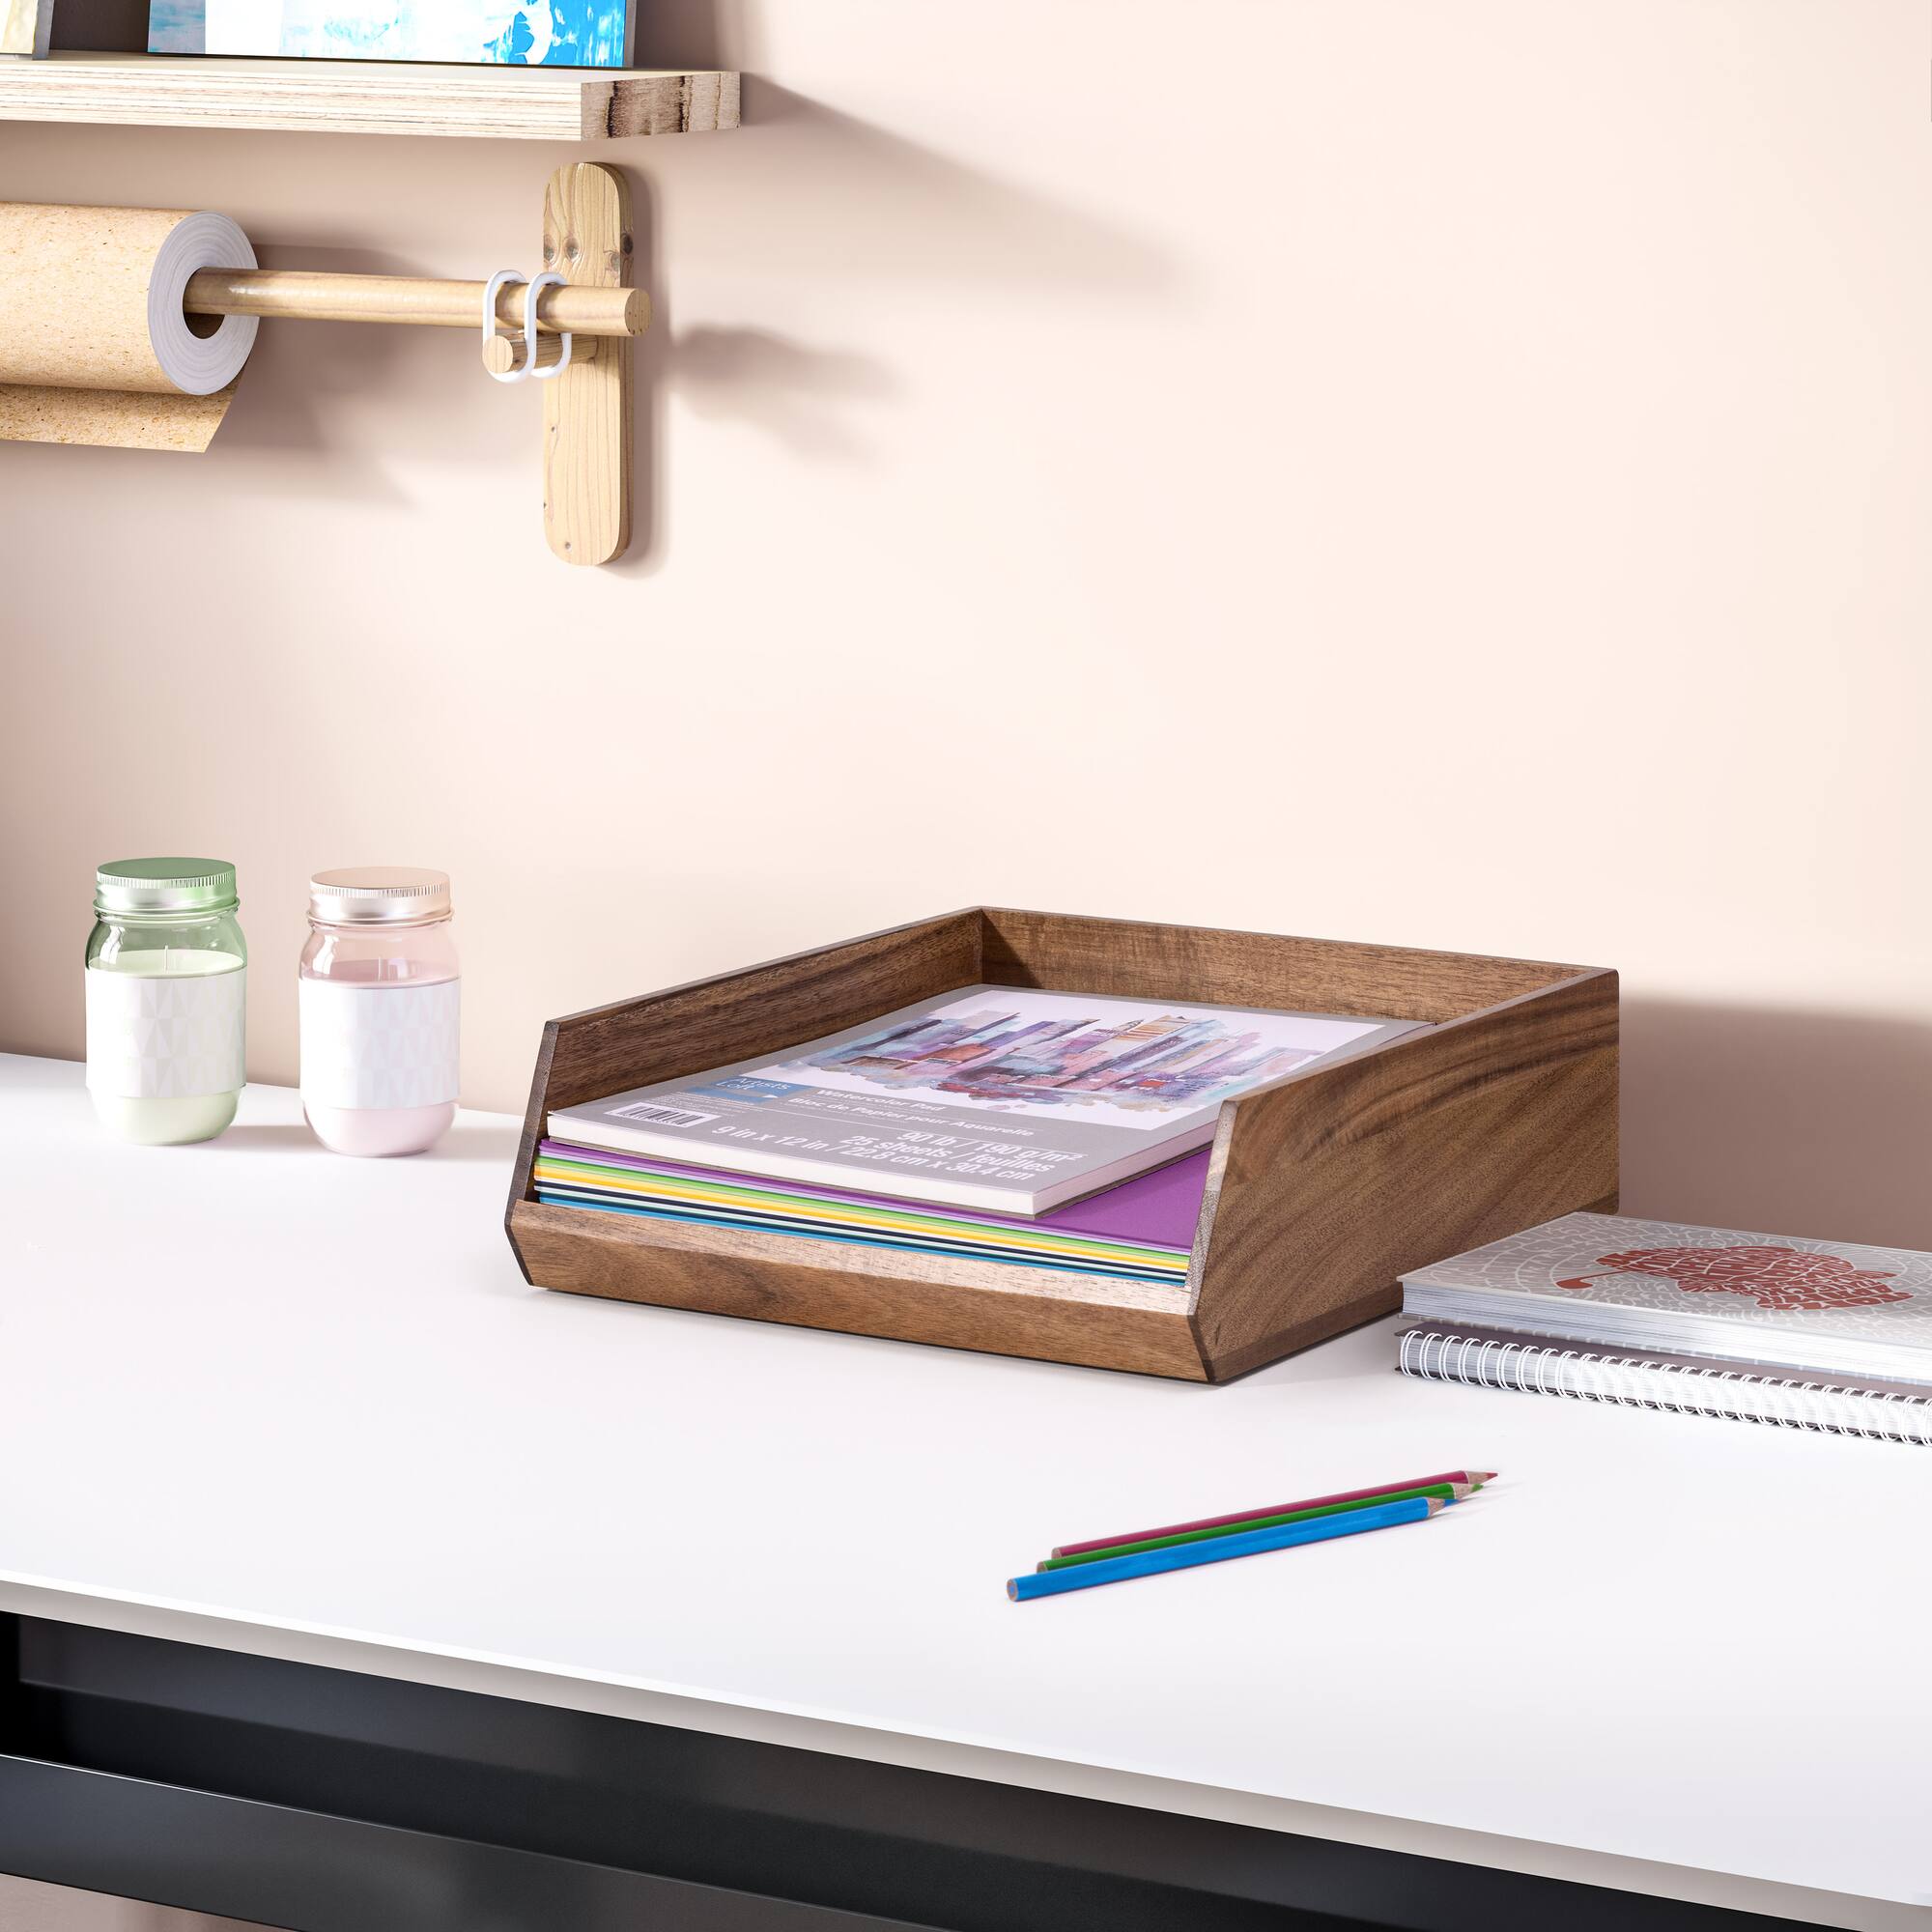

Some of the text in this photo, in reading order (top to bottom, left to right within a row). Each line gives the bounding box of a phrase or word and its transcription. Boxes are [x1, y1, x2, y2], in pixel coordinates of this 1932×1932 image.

[788, 1097, 827, 1106] Bloc
[851, 1107, 907, 1119] Papier
[905, 1116, 950, 1124] pour
[951, 1122, 1036, 1136] Aquarelle
[816, 1090, 906, 1105] Watercolor
[728, 1129, 758, 1138] in
[773, 1136, 809, 1146] 12
[801, 1140, 831, 1150] in
[838, 1146, 896, 1159] 22.8
[889, 1155, 930, 1166] cm
[925, 1160, 947, 1169] x
[945, 1161, 1000, 1176] 30.4
[995, 1170, 1036, 1180] cm
[838, 1135, 880, 1146] 25
[872, 1141, 954, 1158] sheets
[971, 1153, 1056, 1173] feuilles
[896, 1131, 935, 1142] 90
[928, 1136, 958, 1146] lb
[973, 1143, 1021, 1154] 190
